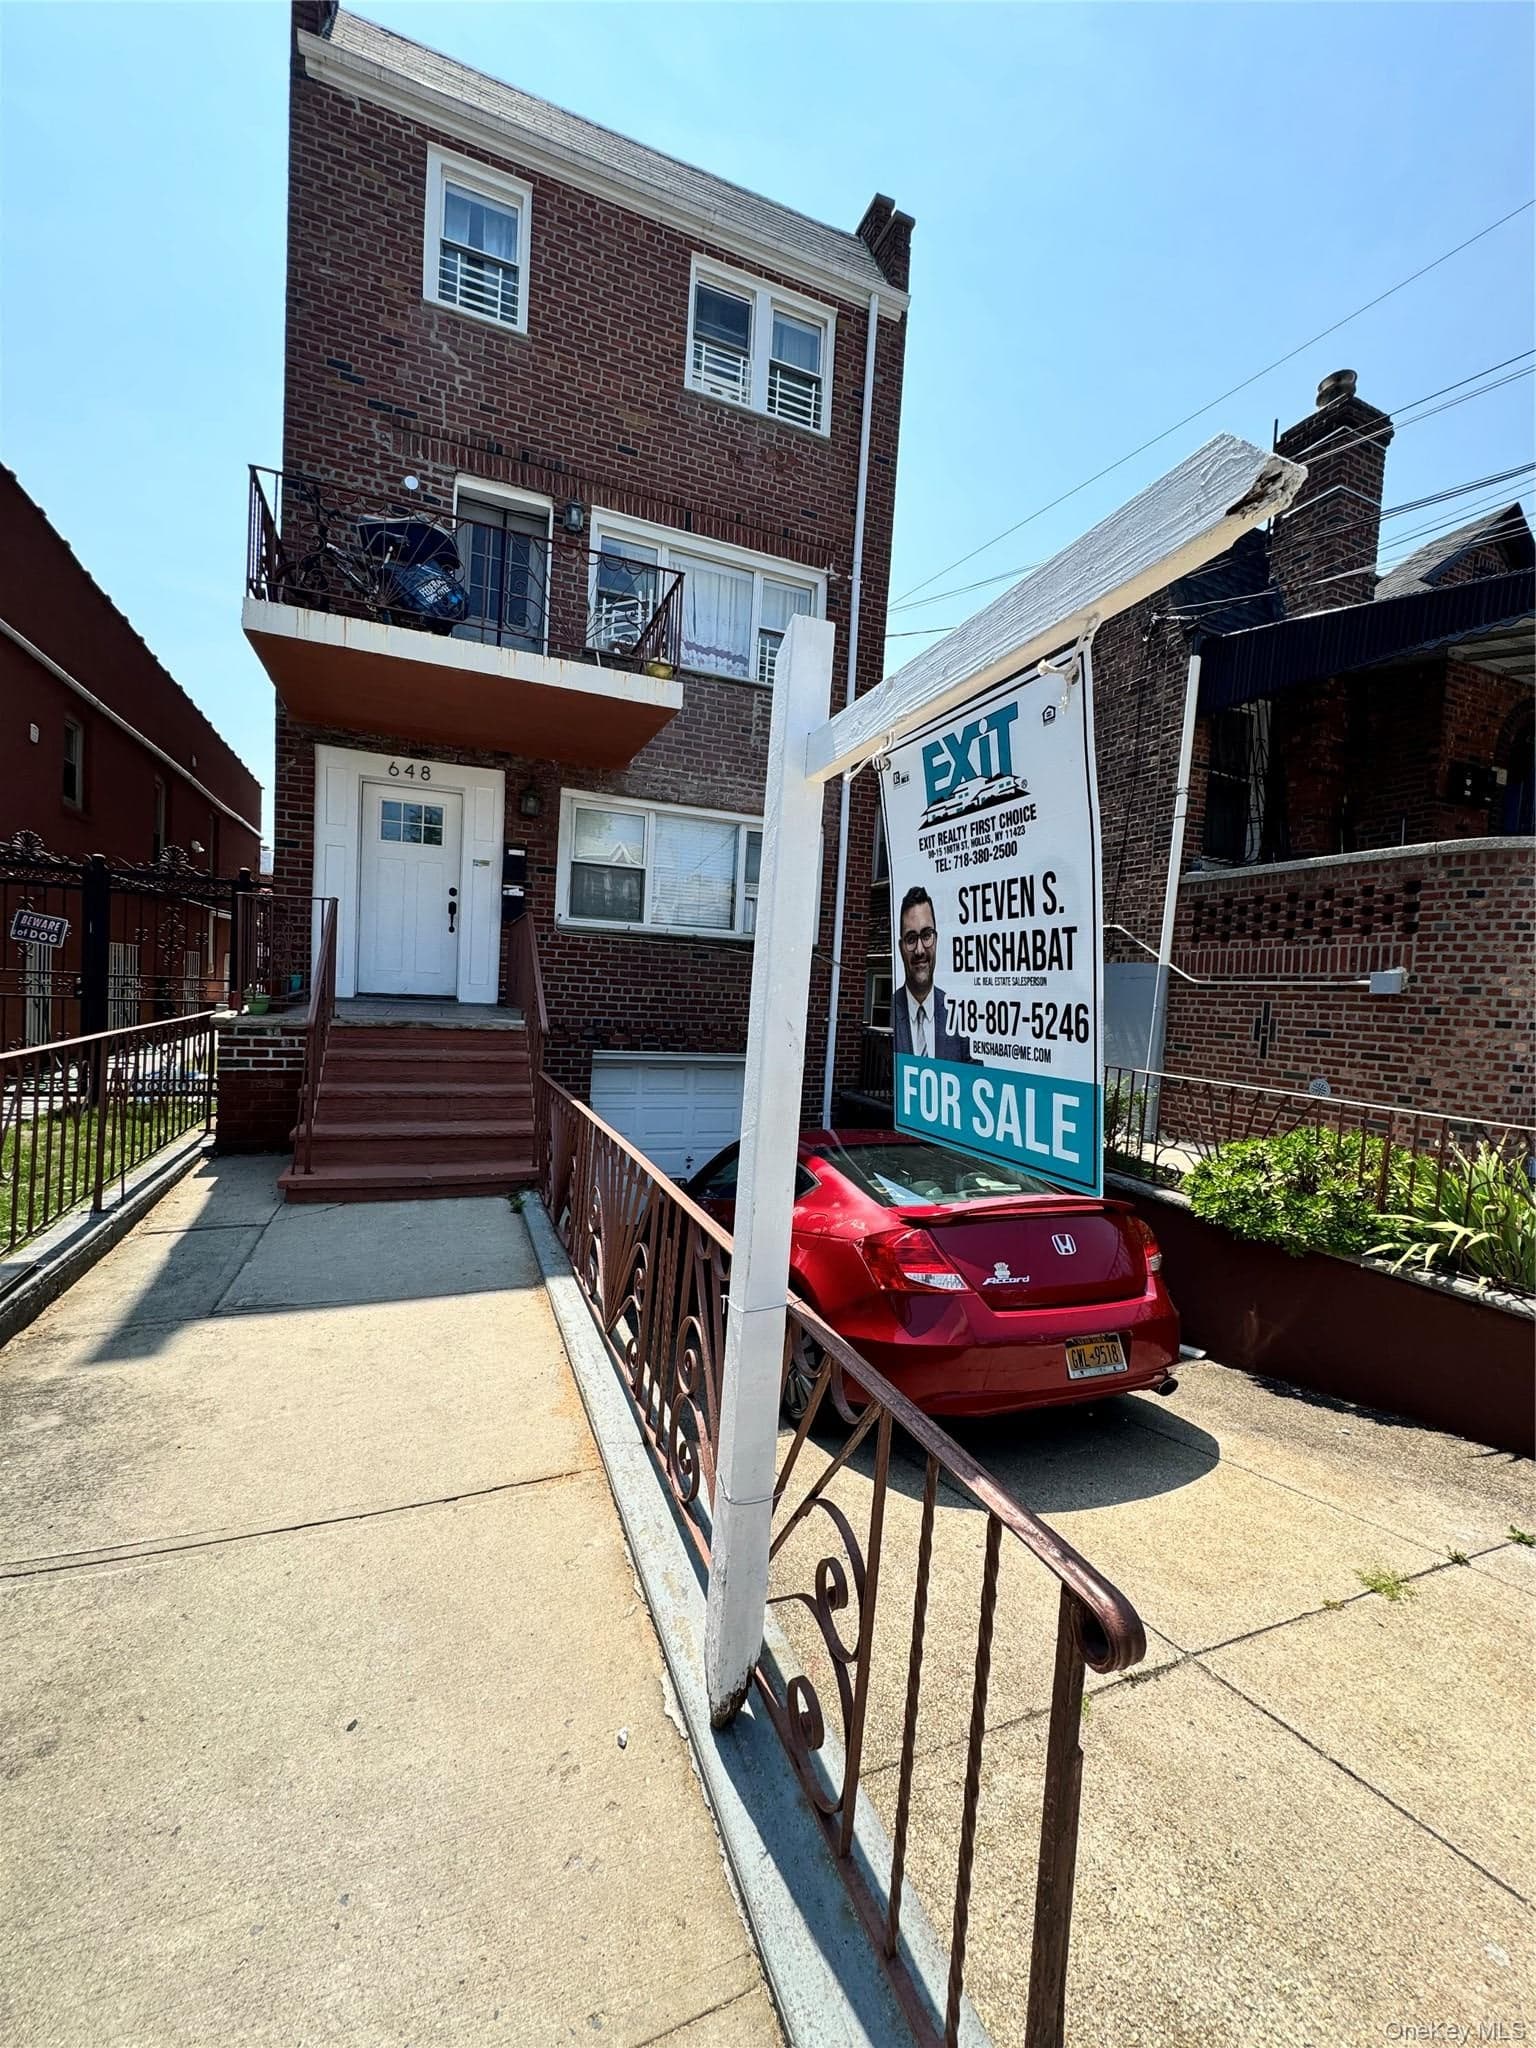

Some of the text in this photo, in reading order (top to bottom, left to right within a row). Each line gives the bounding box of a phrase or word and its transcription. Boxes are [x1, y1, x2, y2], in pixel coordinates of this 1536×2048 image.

[389, 761, 431, 781] 648
[918, 803, 1037, 851] EXIT REALTY FIRST CHOICE
[970, 834, 994, 848] HOLLIS,
[994, 830, 1004, 841] NY
[1005, 825, 1026, 839] 11423
[935, 840, 1018, 873] TEL: 718-380-2500
[958, 870, 1065, 925] STEVEN S.
[20, 915, 61, 931] BEWARE
[17, 929, 58, 943] of DOG
[952, 926, 1078, 973] BENSHABAT
[982, 977, 993, 986] REAL
[994, 977, 1012, 986] ESTATE
[1012, 976, 1048, 987] SALESPERSON
[946, 998, 1089, 1043] 718-807-5246
[973, 1040, 1052, 1063] BENSHABAT@ME.COM
[903, 1064, 1080, 1164] FOR SALE
[982, 1275, 1030, 1286] Accord
